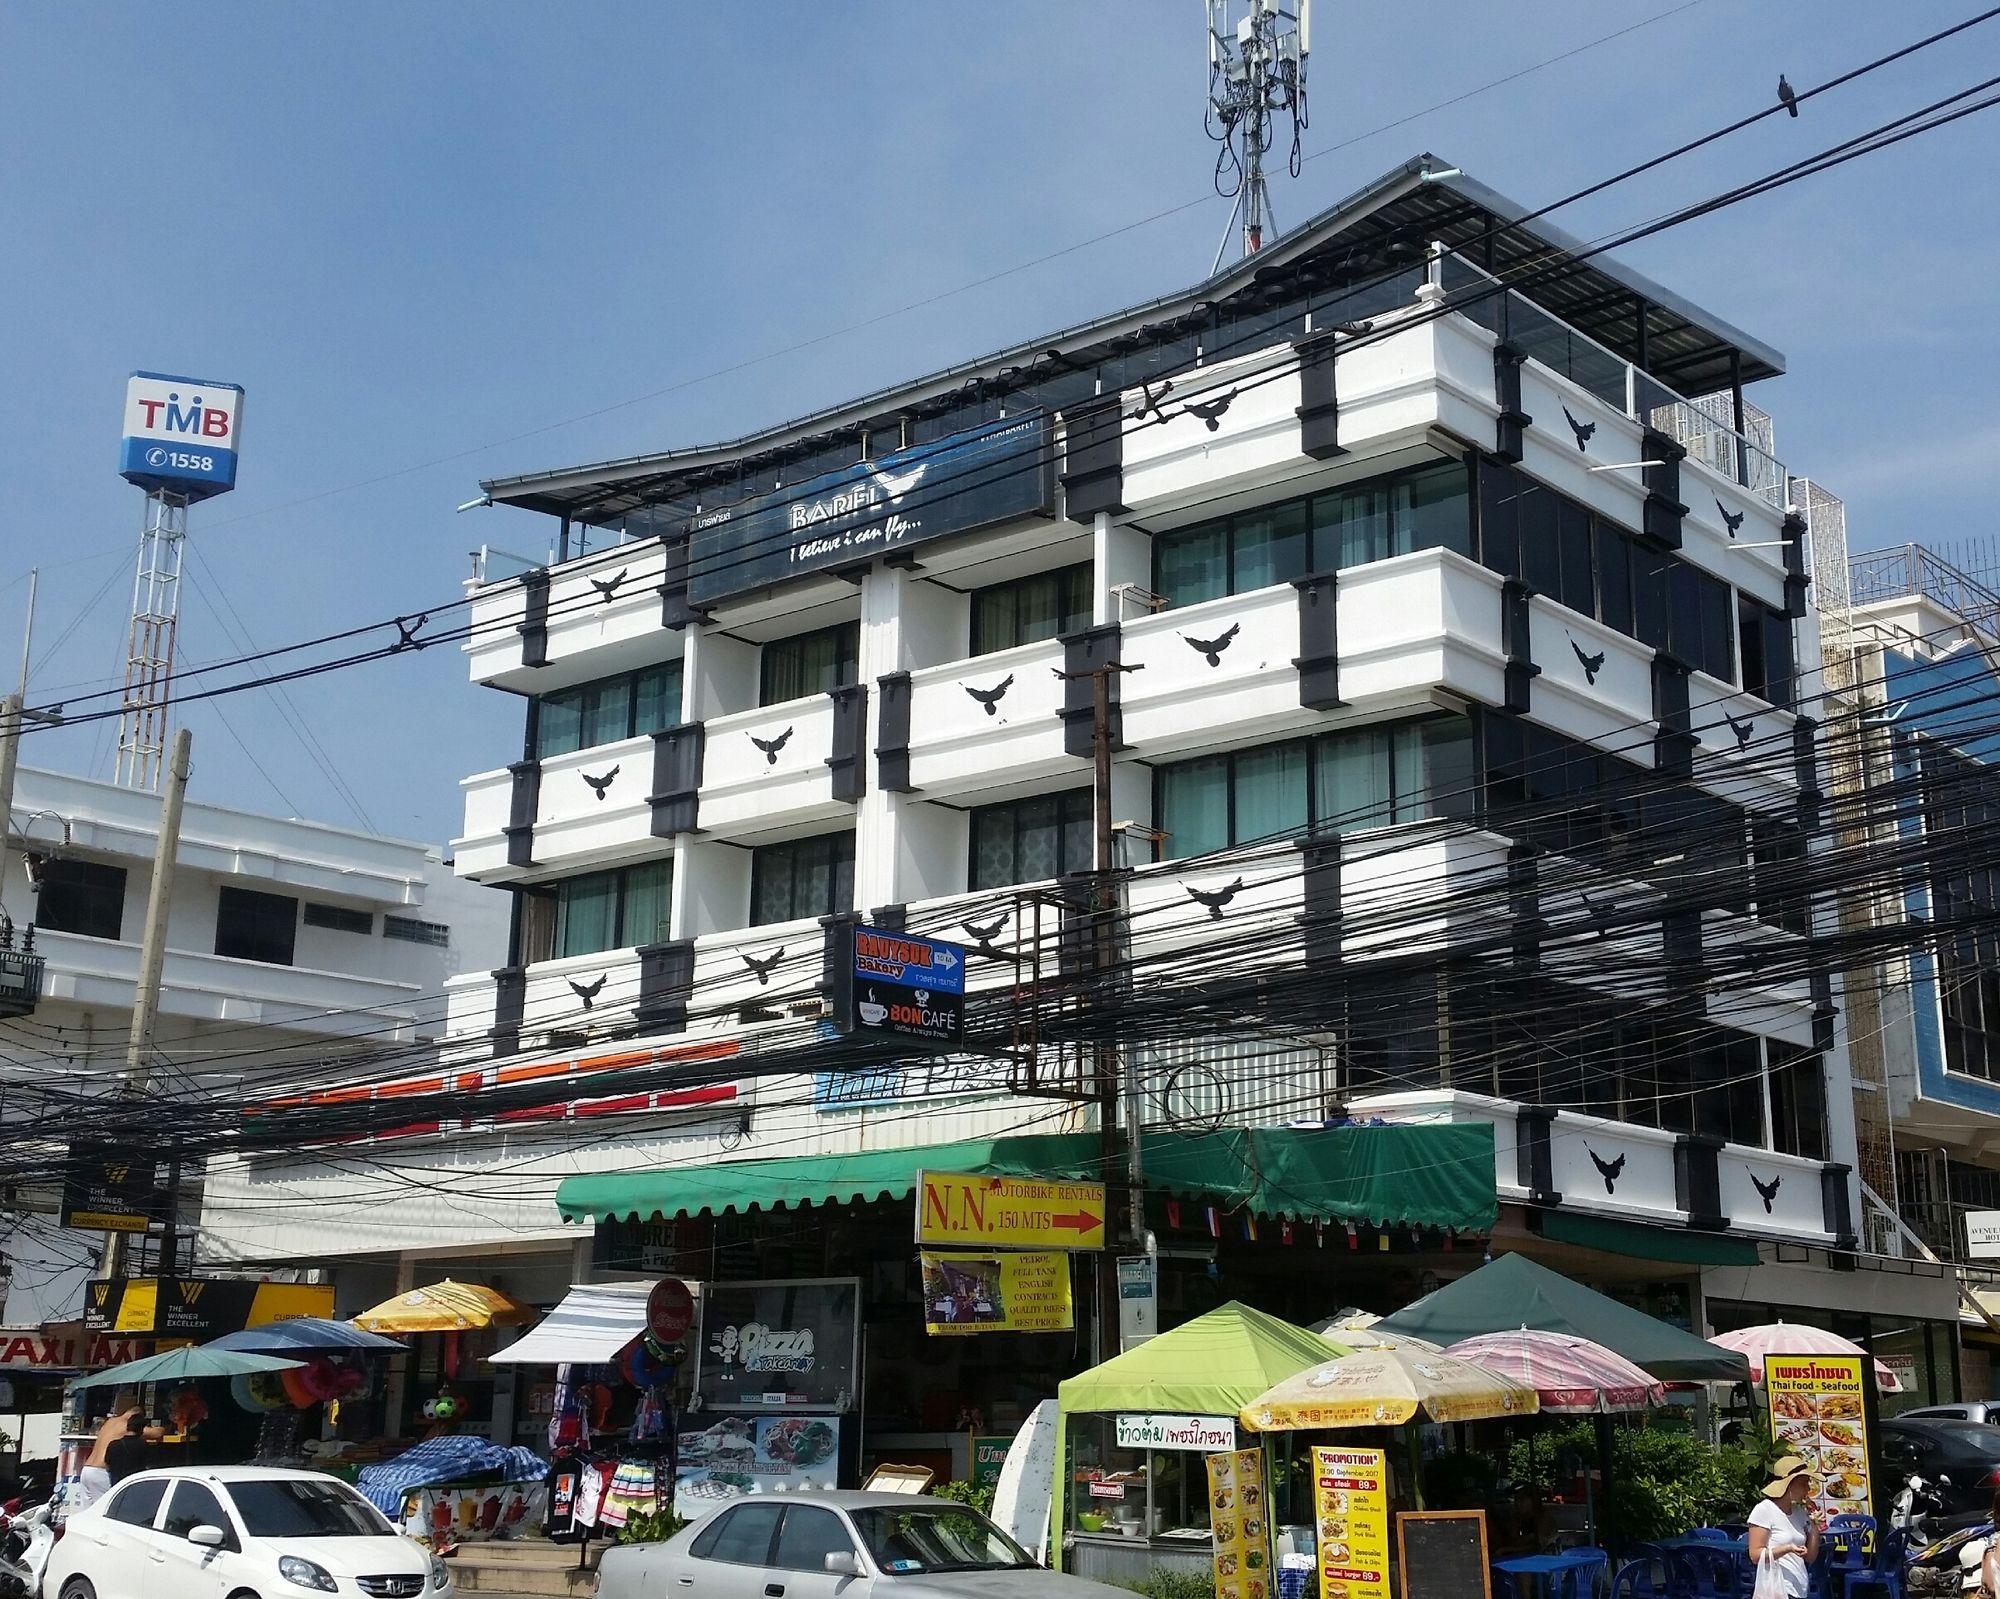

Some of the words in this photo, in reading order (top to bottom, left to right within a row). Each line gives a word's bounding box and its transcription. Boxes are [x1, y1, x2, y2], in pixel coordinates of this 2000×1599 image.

[138, 393, 229, 438] TMB
[169, 452, 213, 471] 1558
[799, 537, 840, 561] believe
[855, 528, 882, 543] can
[857, 957, 905, 979] Bakery
[890, 1004, 956, 1030] BONCAFÉ
[90, 1187, 106, 1196] THE
[990, 1185, 1053, 1200] MOTORBIKE
[1058, 1187, 1102, 1201] RENTALS
[89, 1196, 124, 1205] WINNER
[923, 1183, 993, 1232] N.N.
[73, 1217, 108, 1226] CURRENCY
[998, 1211, 1017, 1229] 150
[1022, 1211, 1050, 1230] MTS
[1018, 1280, 1053, 1289] ENGLISH
[167, 1313, 199, 1321] WINNER
[1009, 1305, 1041, 1314] QUALITY
[166, 1320, 210, 1328] EXCELLENT
[738, 1322, 814, 1363] Pizza
[1771, 1381, 1791, 1390] Thai
